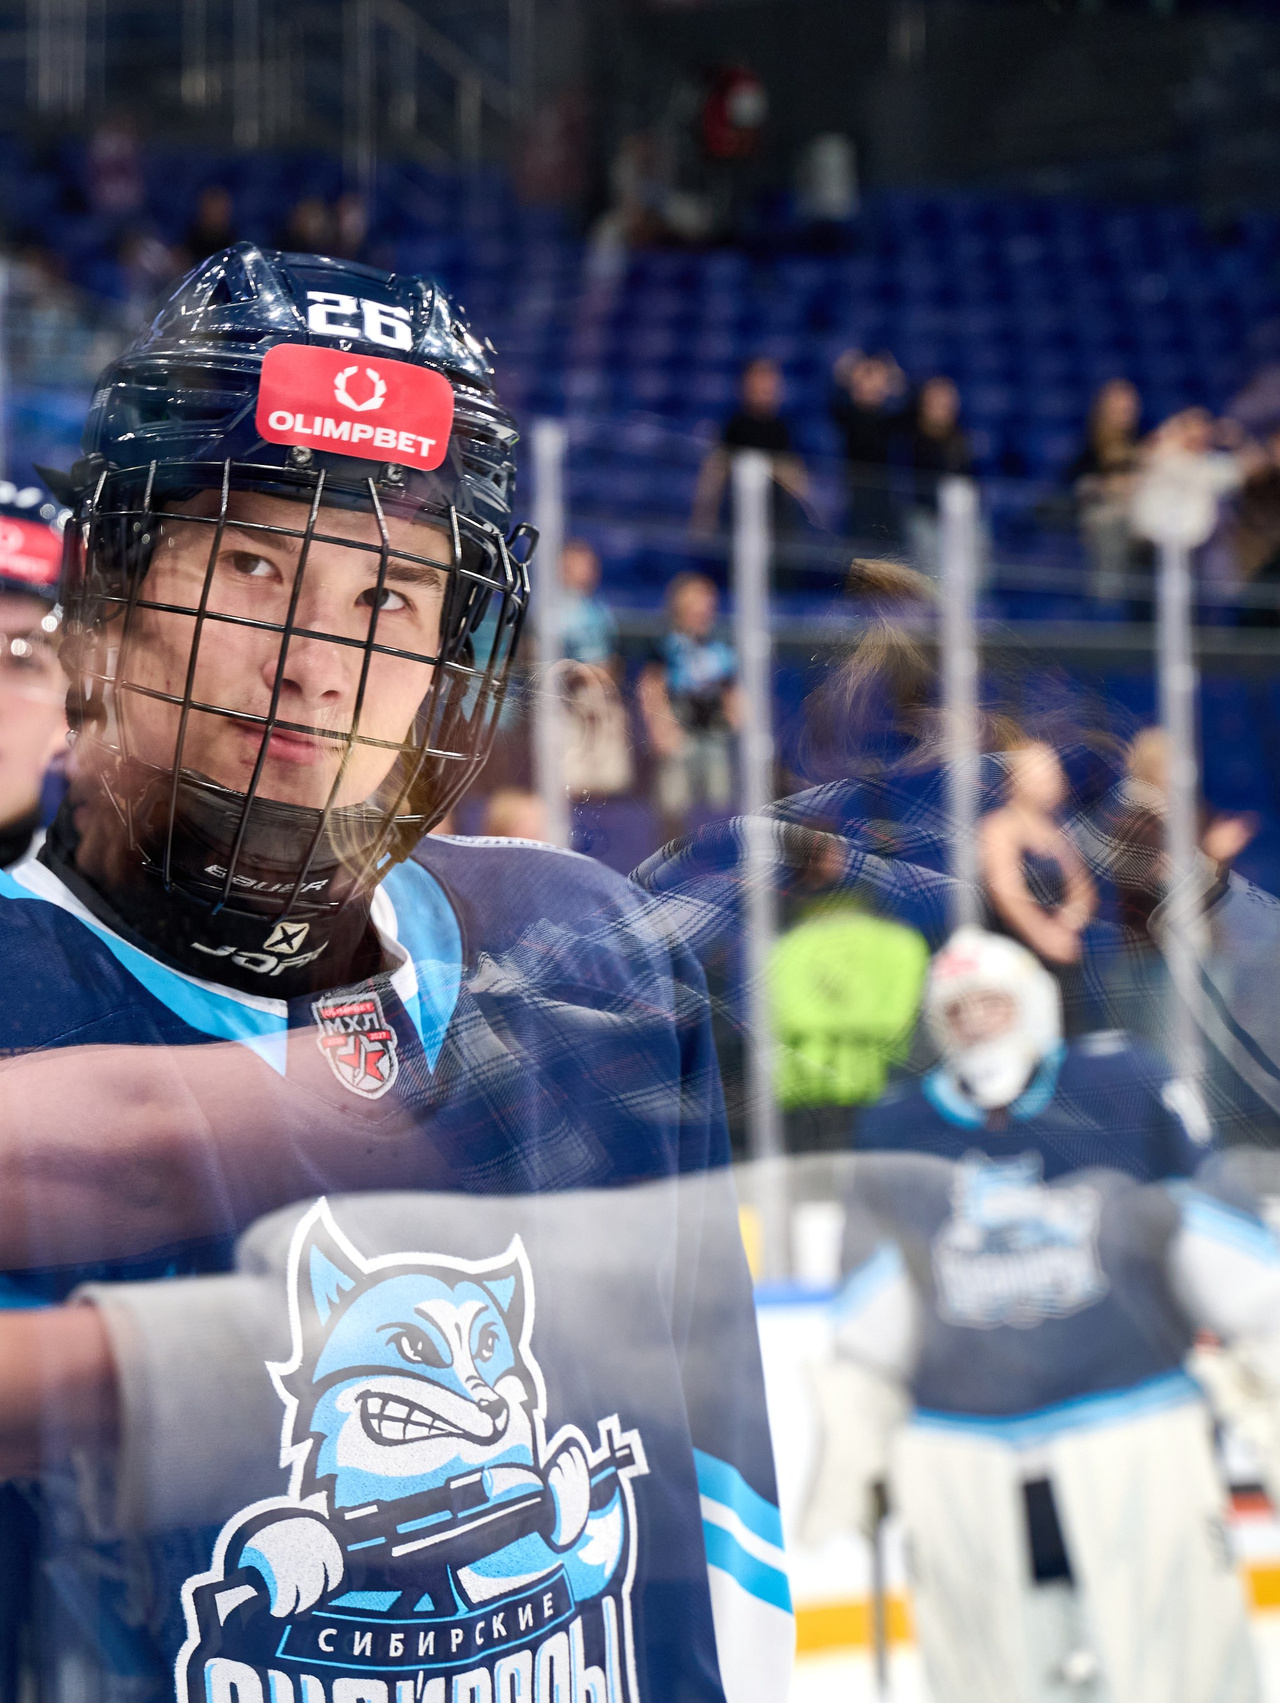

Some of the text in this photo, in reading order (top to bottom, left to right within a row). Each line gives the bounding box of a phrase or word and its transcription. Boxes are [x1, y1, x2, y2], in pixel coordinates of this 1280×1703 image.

[306, 291, 414, 352] 26
[268, 410, 437, 458] OLIMPBET
[324, 1012, 380, 1036] МХЛ
[317, 1591, 556, 1658] СИБИРСКИЕ
